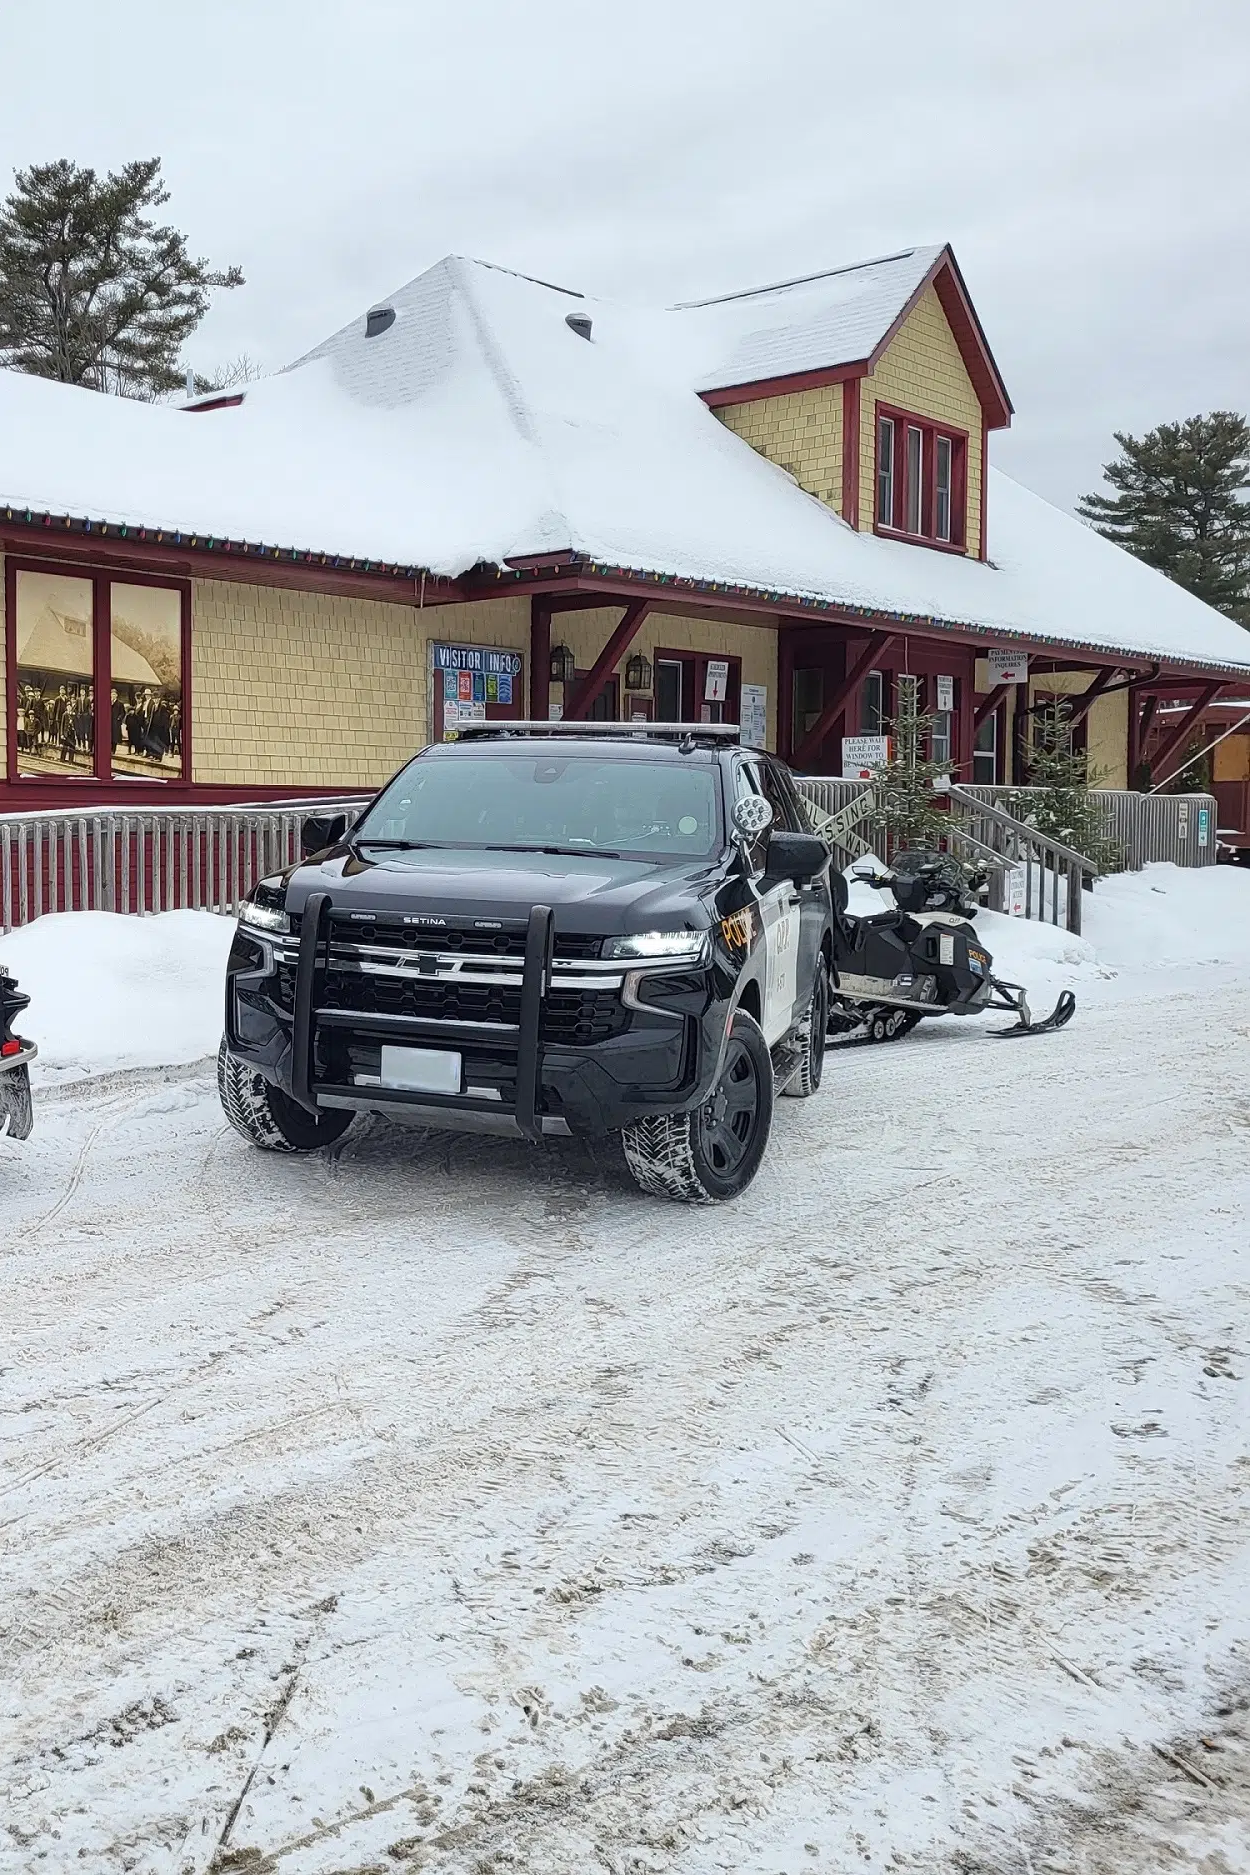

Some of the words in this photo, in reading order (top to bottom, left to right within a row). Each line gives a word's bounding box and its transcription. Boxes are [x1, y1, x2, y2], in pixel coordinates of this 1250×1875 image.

[439, 648, 481, 670] VISITOR
[489, 653, 511, 673] INFO
[845, 833, 871, 855] WAY
[403, 916, 447, 926] SETINA
[968, 949, 987, 965] POLICE
